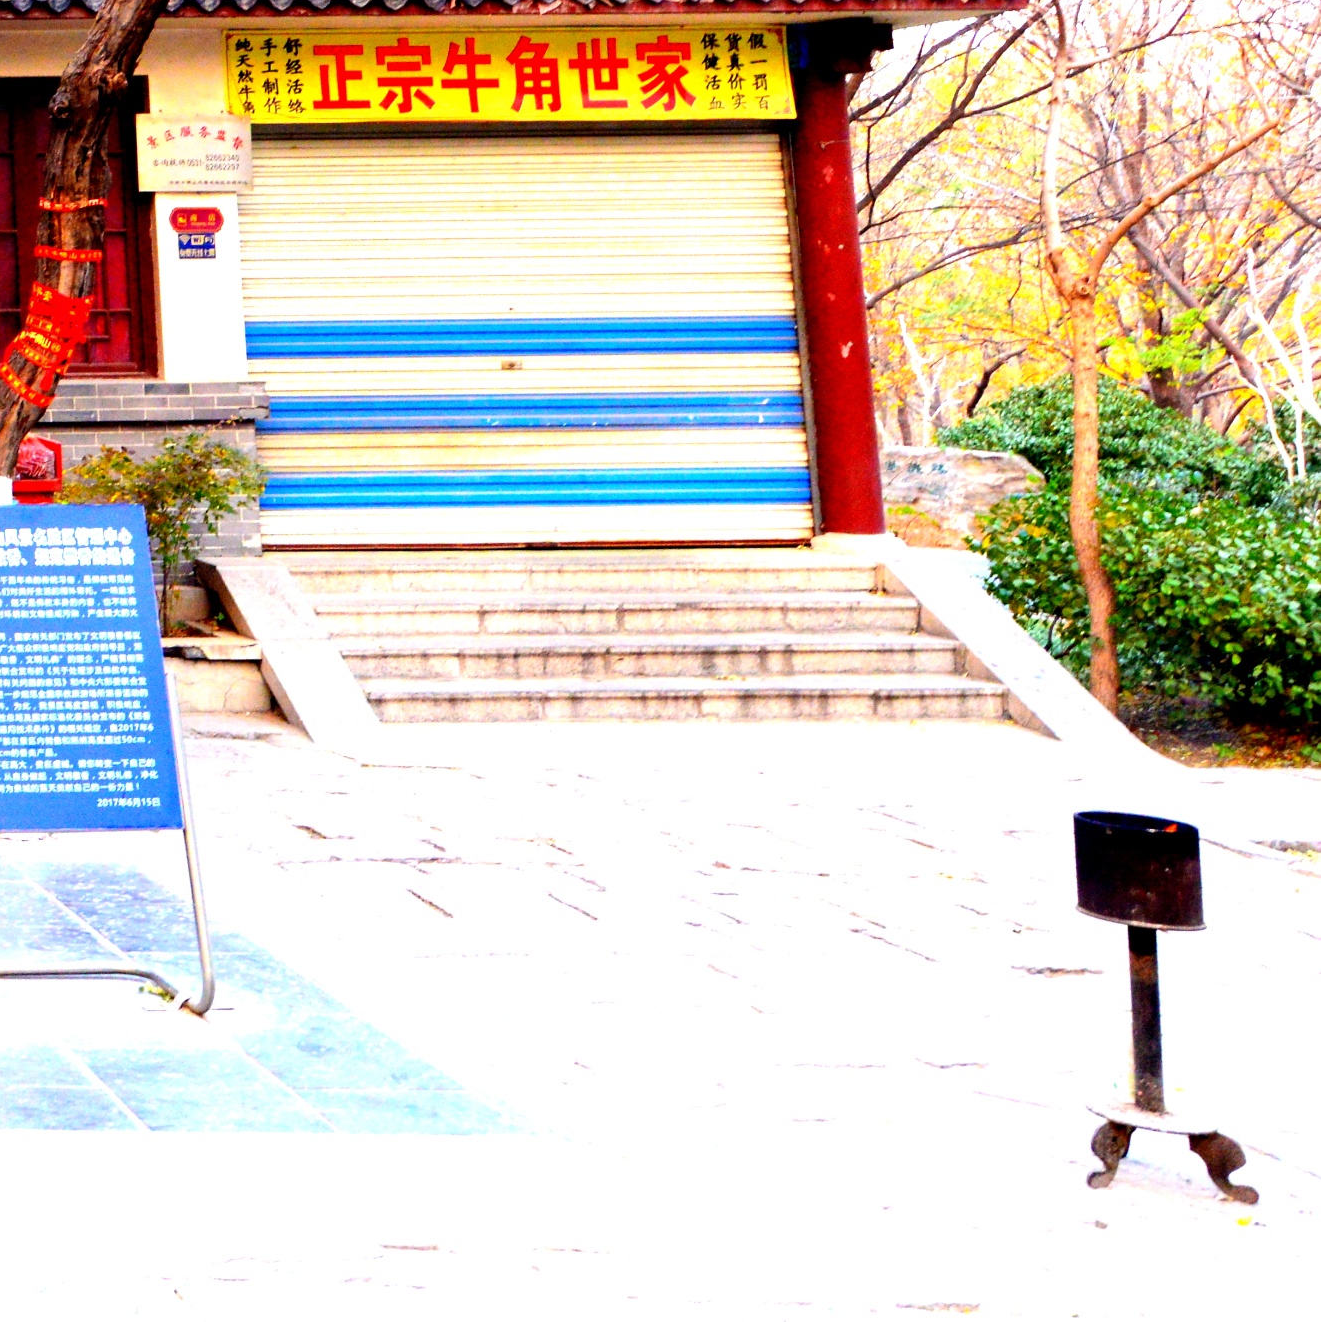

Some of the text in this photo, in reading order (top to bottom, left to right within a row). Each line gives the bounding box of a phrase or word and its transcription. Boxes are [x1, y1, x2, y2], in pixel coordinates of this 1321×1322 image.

[234, 37, 256, 114] 纯天然牛角
[260, 37, 282, 114] 手工制作
[282, 37, 307, 114] 舒经活络
[312, 33, 697, 114] 正宗牛角世家
[700, 31, 726, 110] 保健活血
[724, 32, 748, 110] 货真价实
[746, 32, 771, 111] 假一罚百
[96, 797, 161, 808] 2017年6月15日
